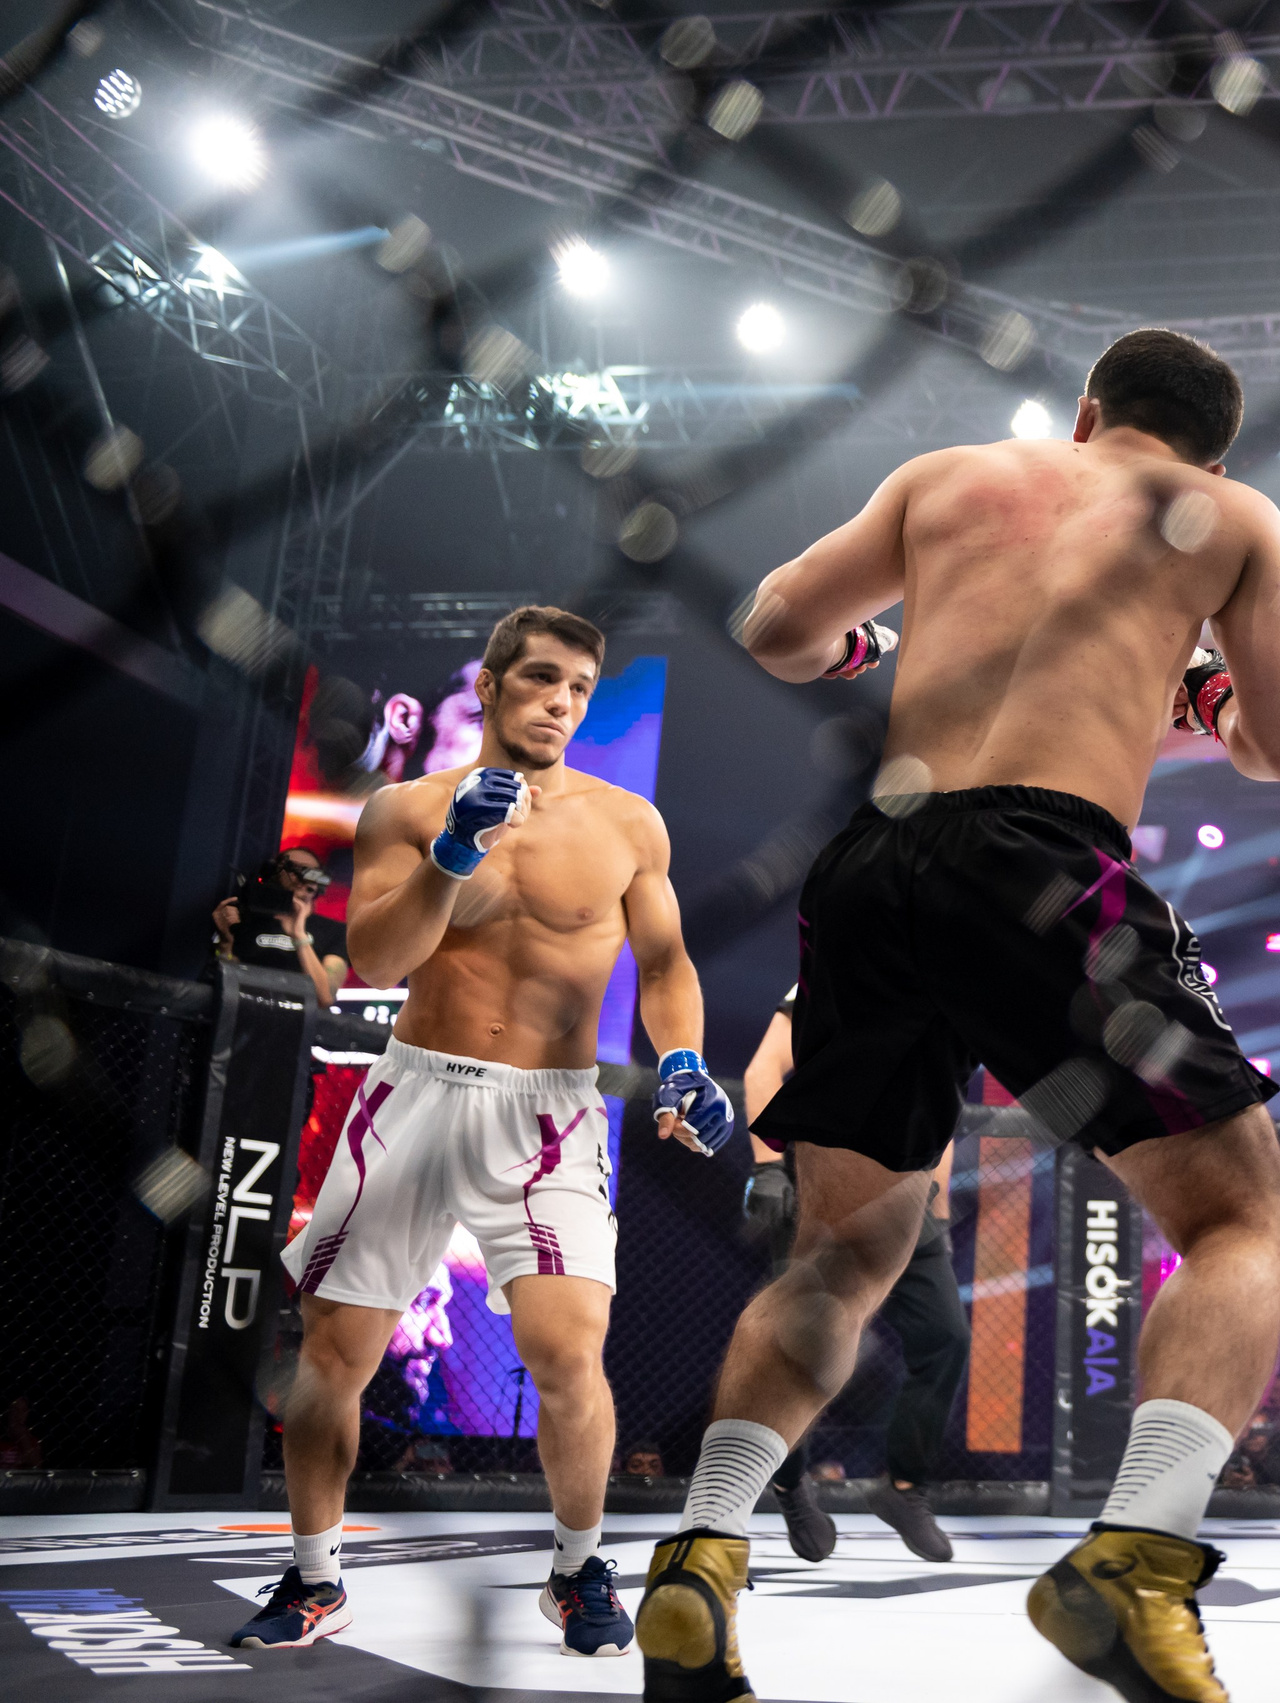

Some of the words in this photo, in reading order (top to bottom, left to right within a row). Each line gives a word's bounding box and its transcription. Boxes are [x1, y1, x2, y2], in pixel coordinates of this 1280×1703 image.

[446, 1062, 487, 1078] HYPE
[222, 1136, 236, 1173] NEW
[213, 1173, 231, 1222] LEVEL
[222, 1138, 280, 1330] NLP
[198, 1223, 224, 1329] PRODUCTION
